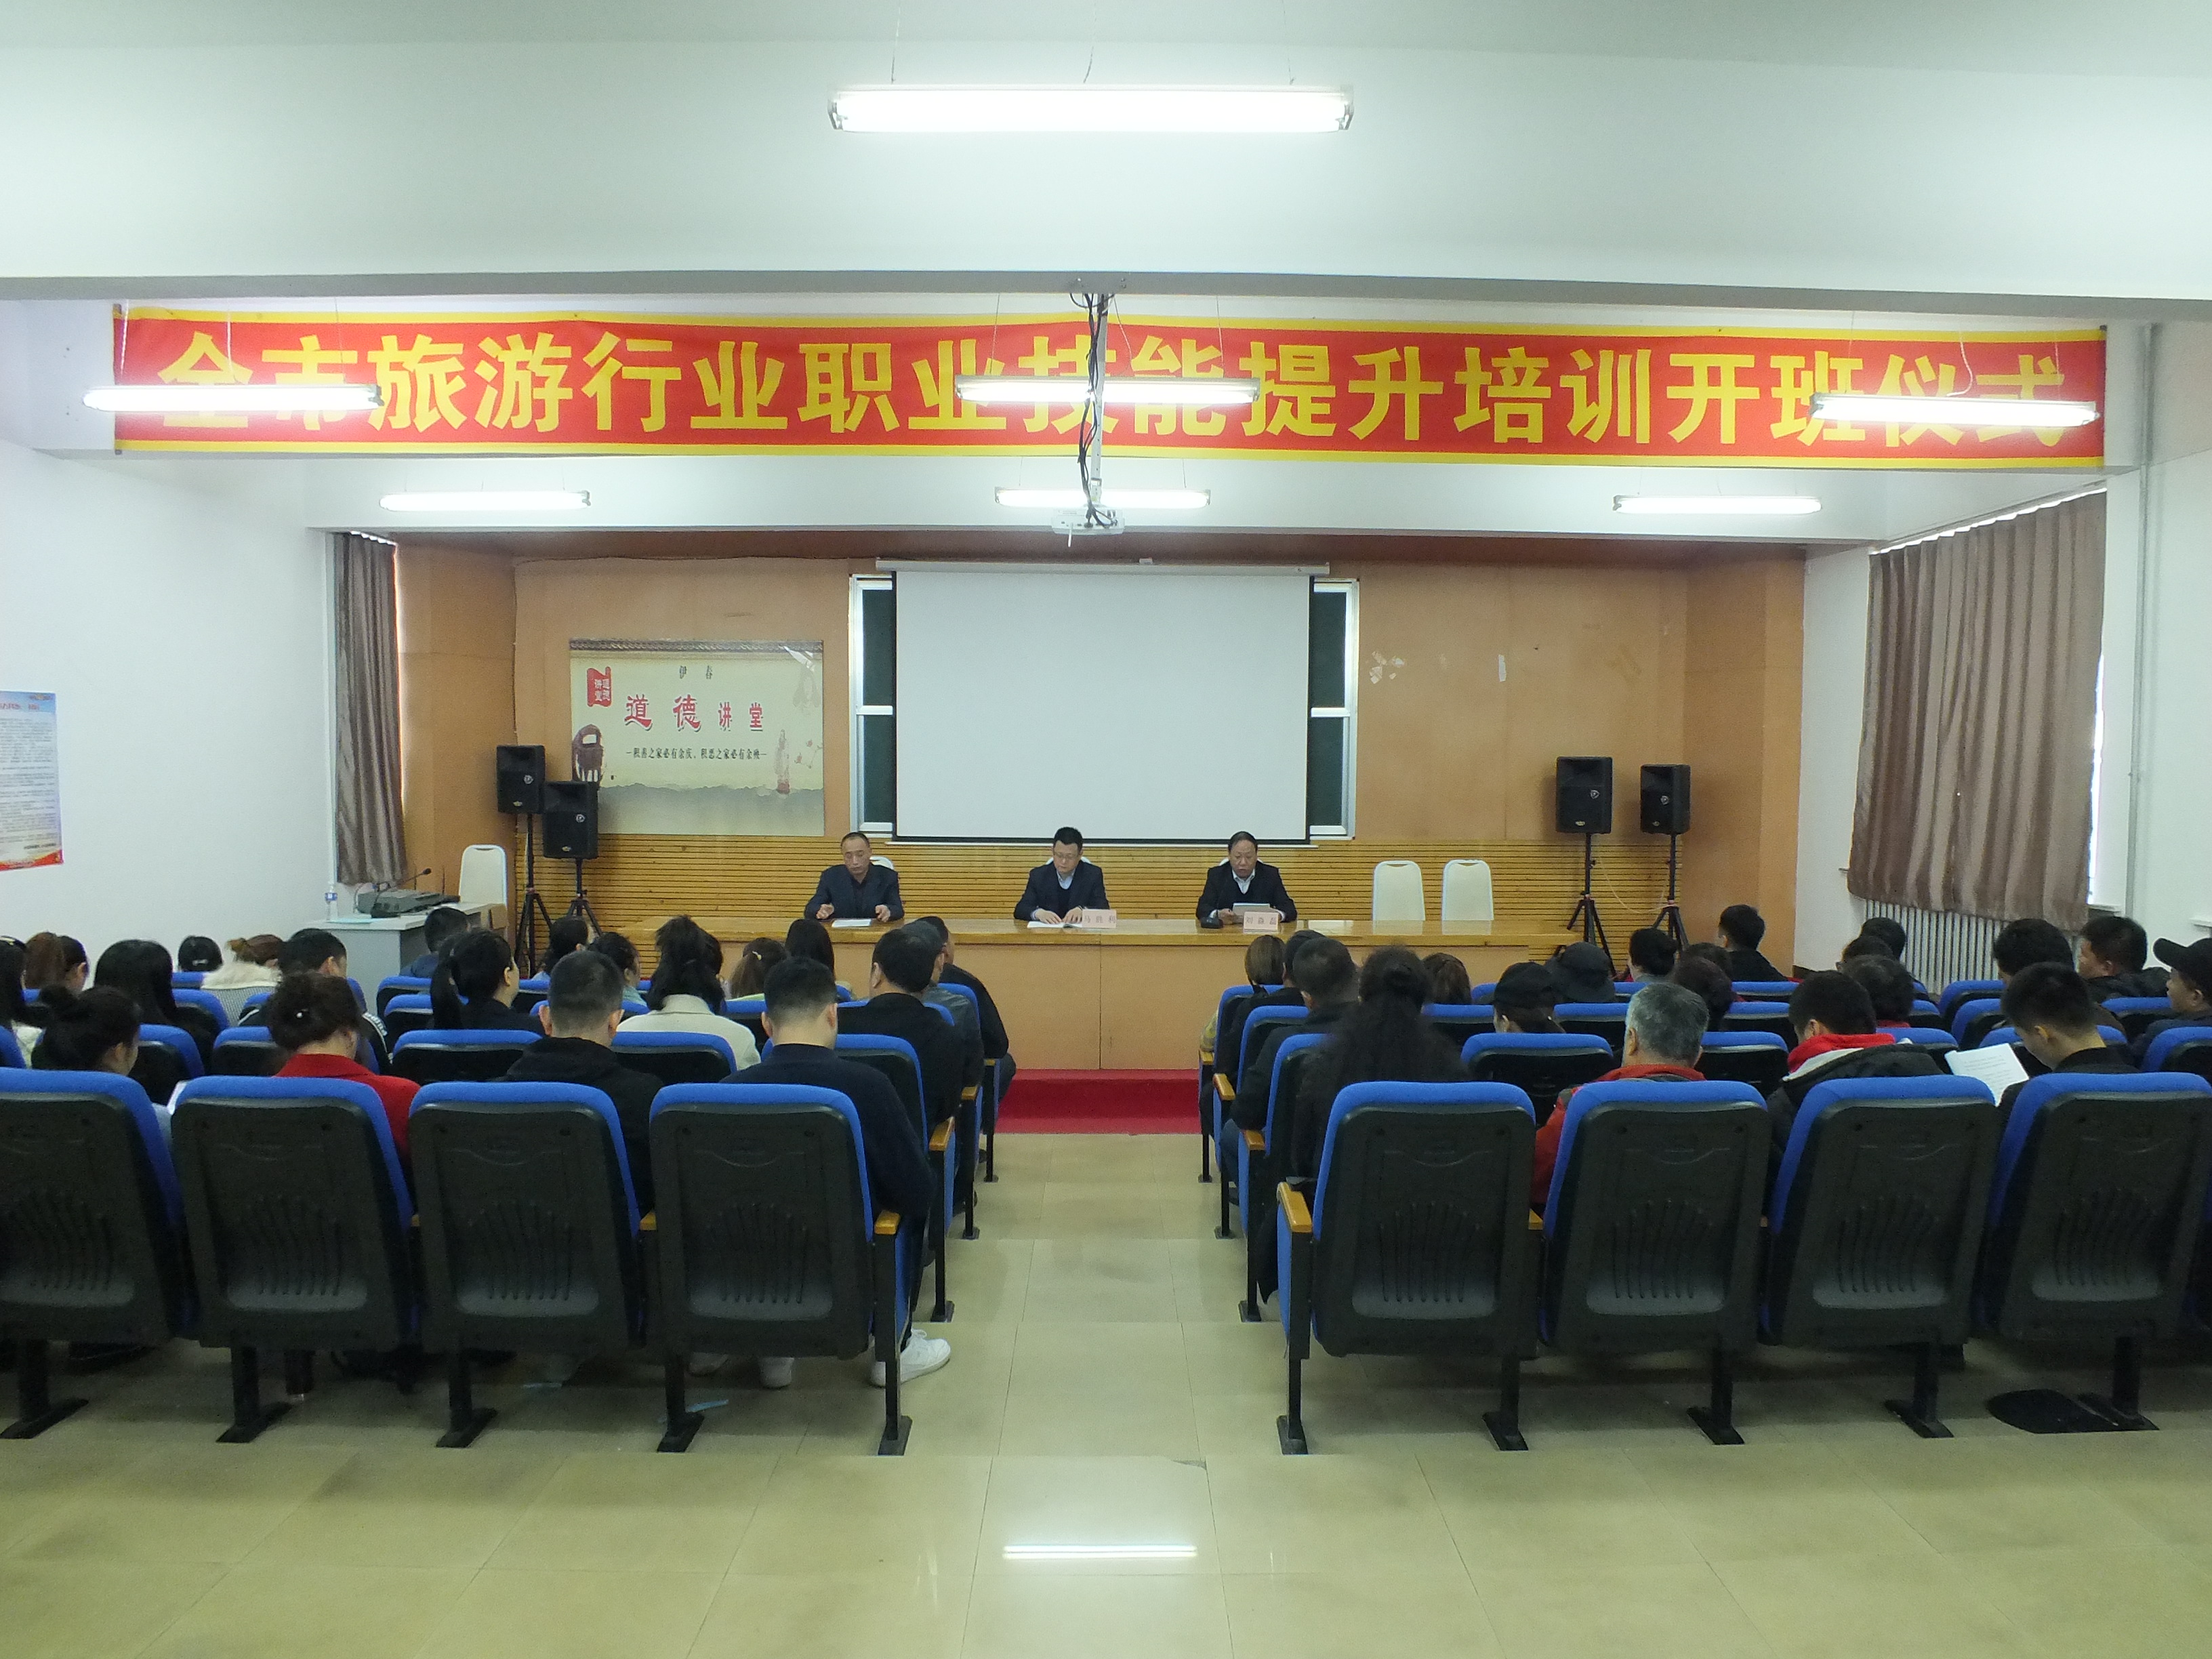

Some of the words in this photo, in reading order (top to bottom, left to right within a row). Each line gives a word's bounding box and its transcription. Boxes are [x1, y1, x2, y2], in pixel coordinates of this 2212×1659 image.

[157, 330, 2065, 447] 全市旅游行业职业技能提升培训开班仪式
[624, 693, 764, 732] 道德讲堂
